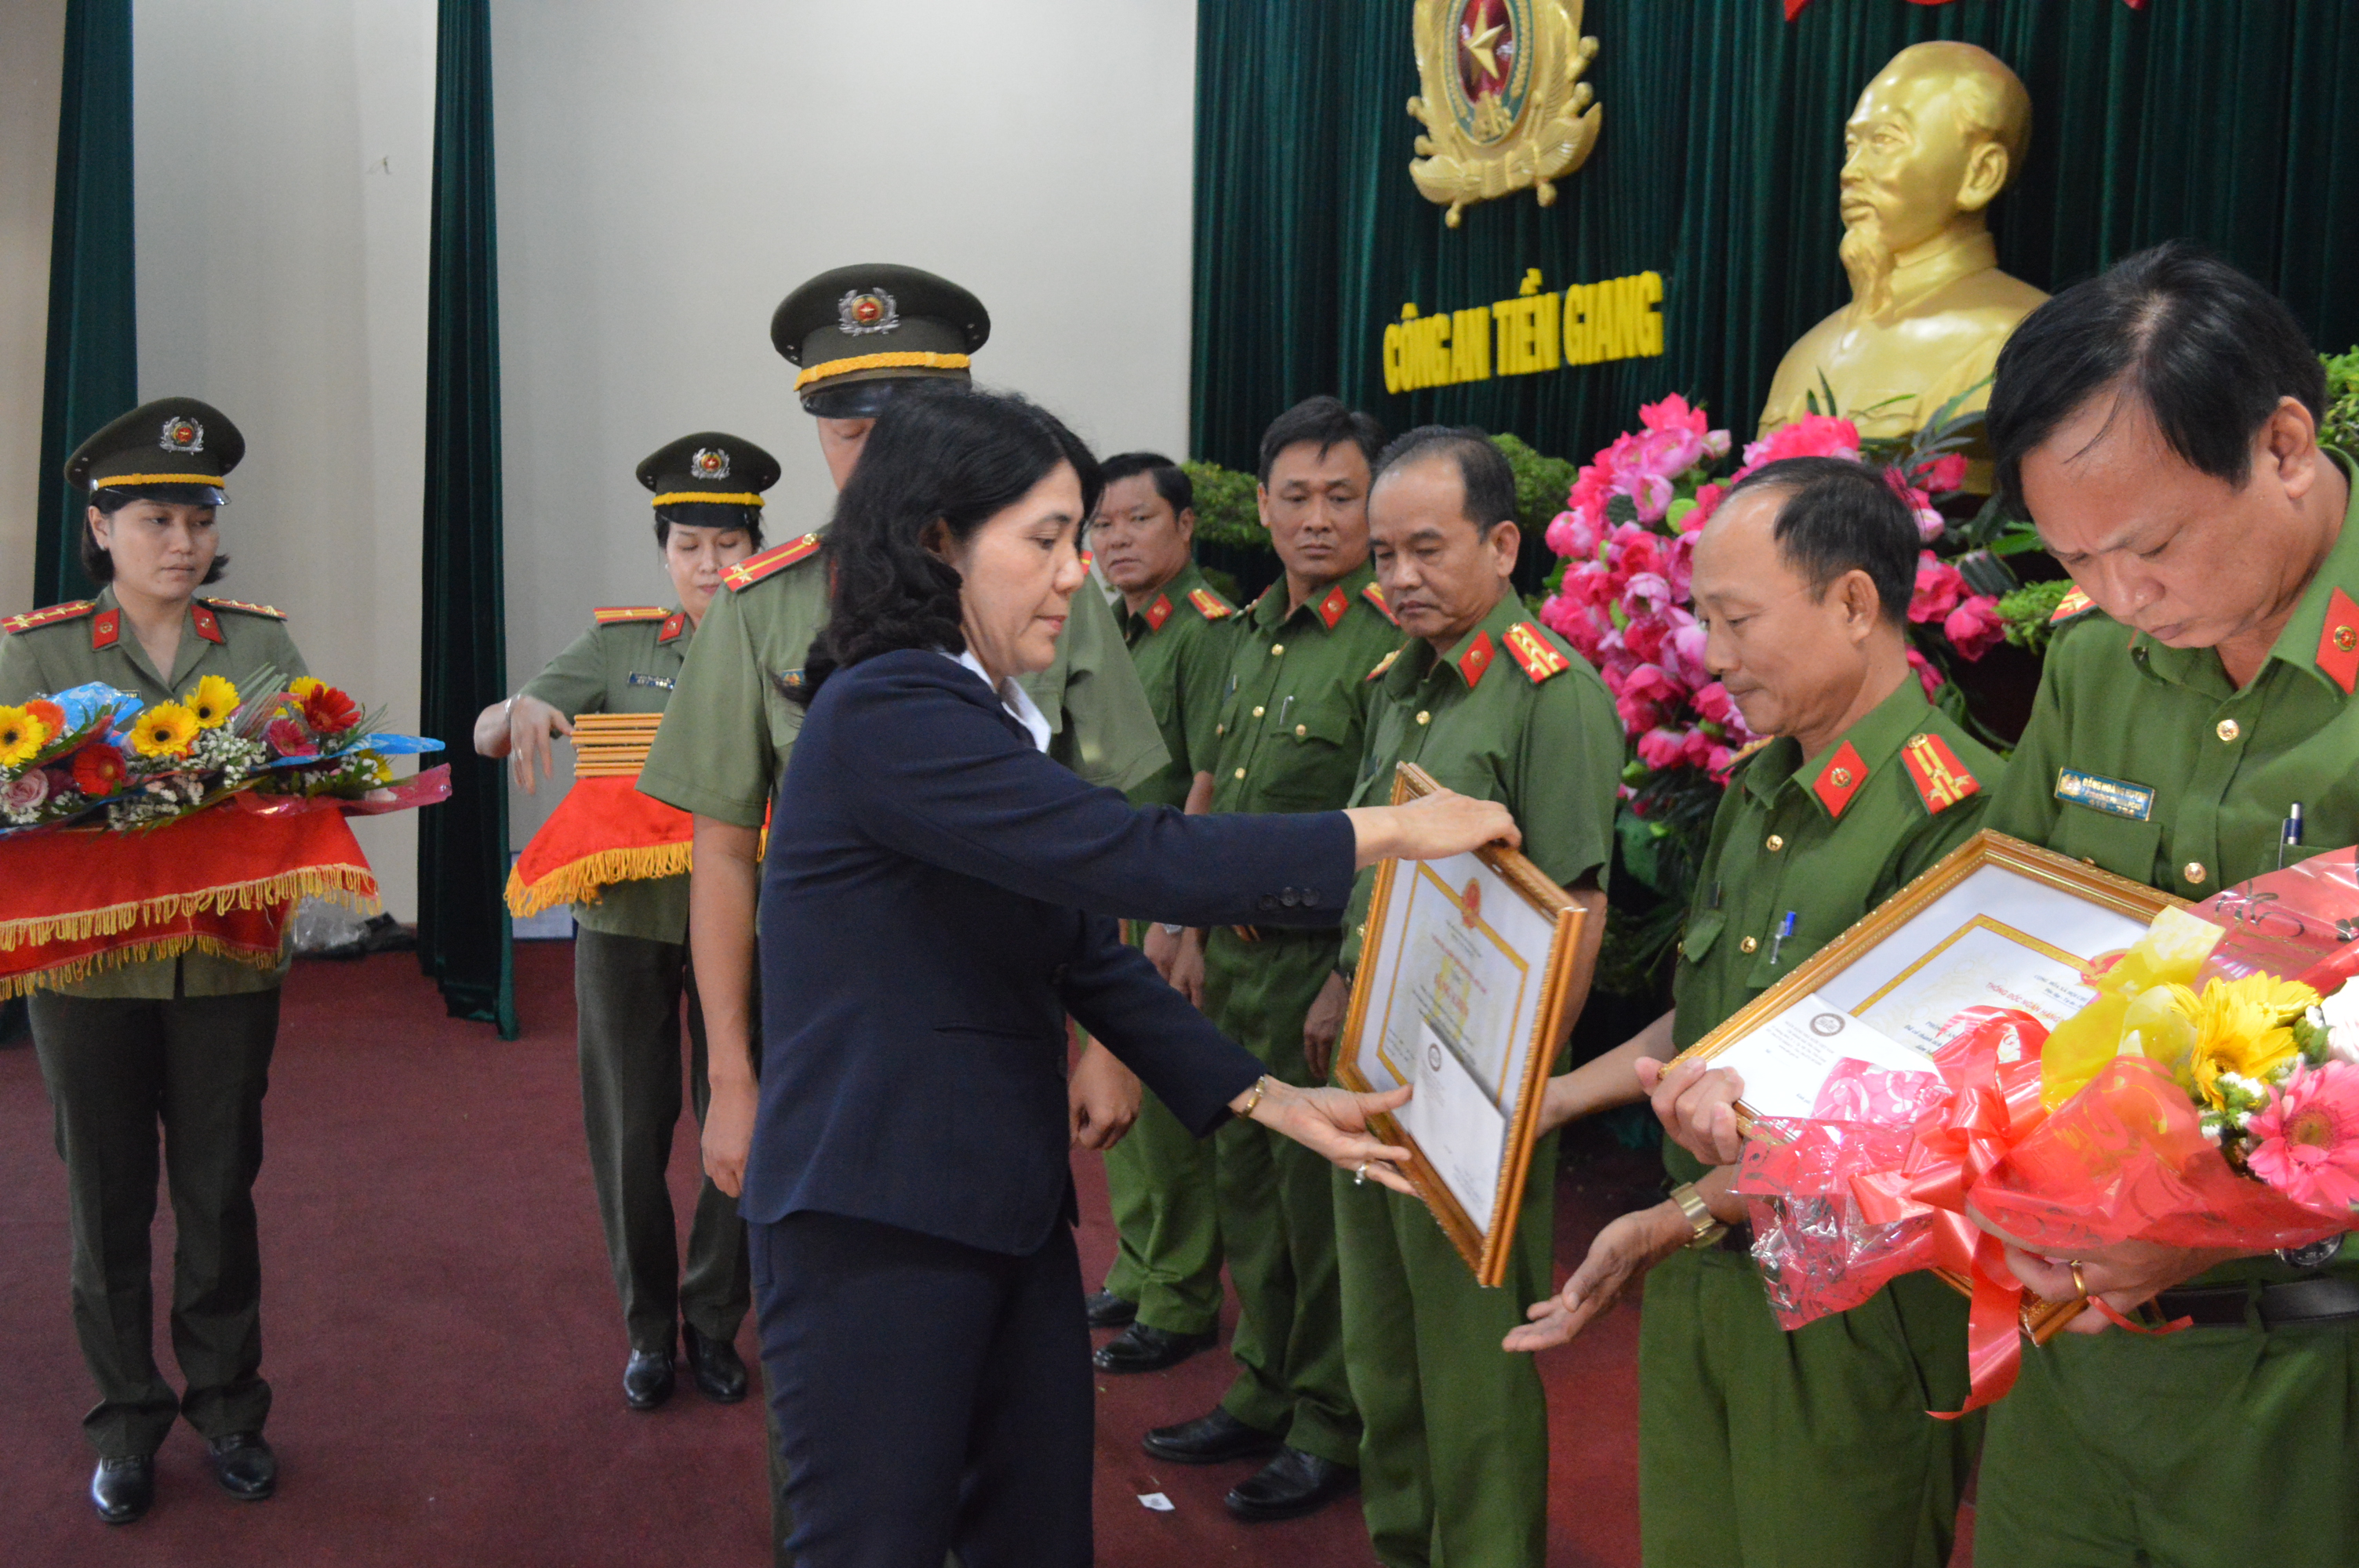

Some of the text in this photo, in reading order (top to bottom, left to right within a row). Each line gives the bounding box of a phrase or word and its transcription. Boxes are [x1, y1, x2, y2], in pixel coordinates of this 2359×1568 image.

[1383, 302, 1451, 394] CÔNG
[1452, 306, 1490, 382] AN
[1564, 270, 1663, 366] GIANG
